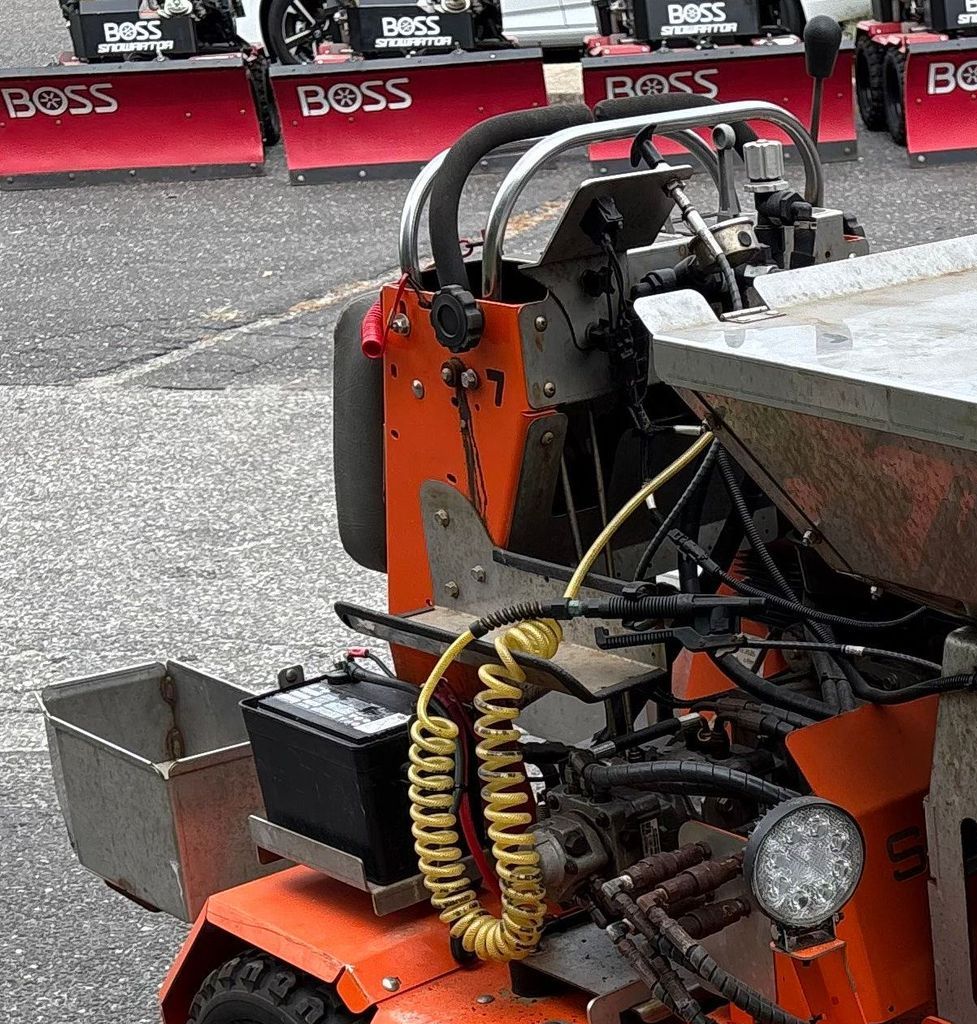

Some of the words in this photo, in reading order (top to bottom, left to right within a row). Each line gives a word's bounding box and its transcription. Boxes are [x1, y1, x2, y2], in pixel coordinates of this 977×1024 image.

[382, 16, 441, 37] BOSS
[668, 2, 726, 24] BOSS
[103, 20, 162, 42] BOSS
[296, 77, 413, 117] BOSS
[605, 68, 719, 100] BOSS
[1, 83, 118, 118] BOSS
